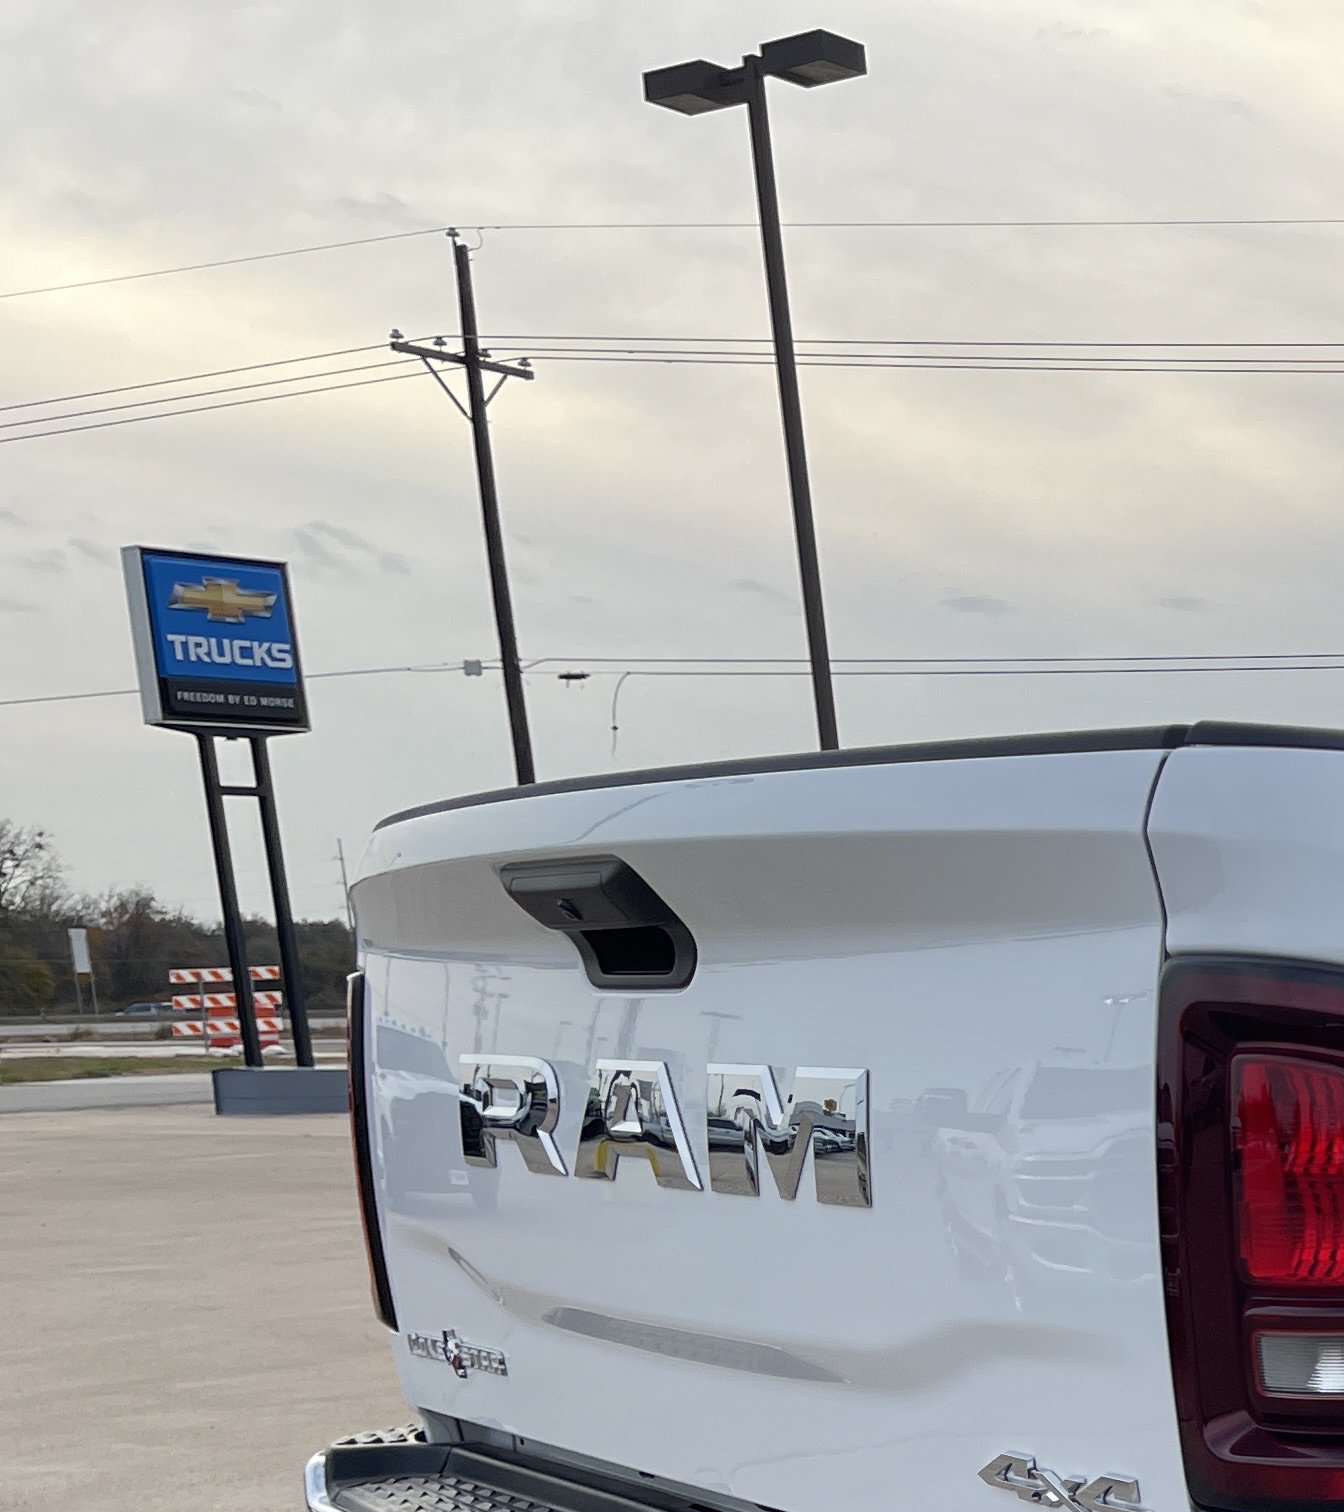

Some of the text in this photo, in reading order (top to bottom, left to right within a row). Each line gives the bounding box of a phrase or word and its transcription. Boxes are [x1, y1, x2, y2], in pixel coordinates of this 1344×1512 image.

[166, 634, 294, 668] TRUCKS
[177, 691, 225, 704] FREEDOM
[227, 694, 241, 705] BY
[458, 1053, 873, 1208] RAM
